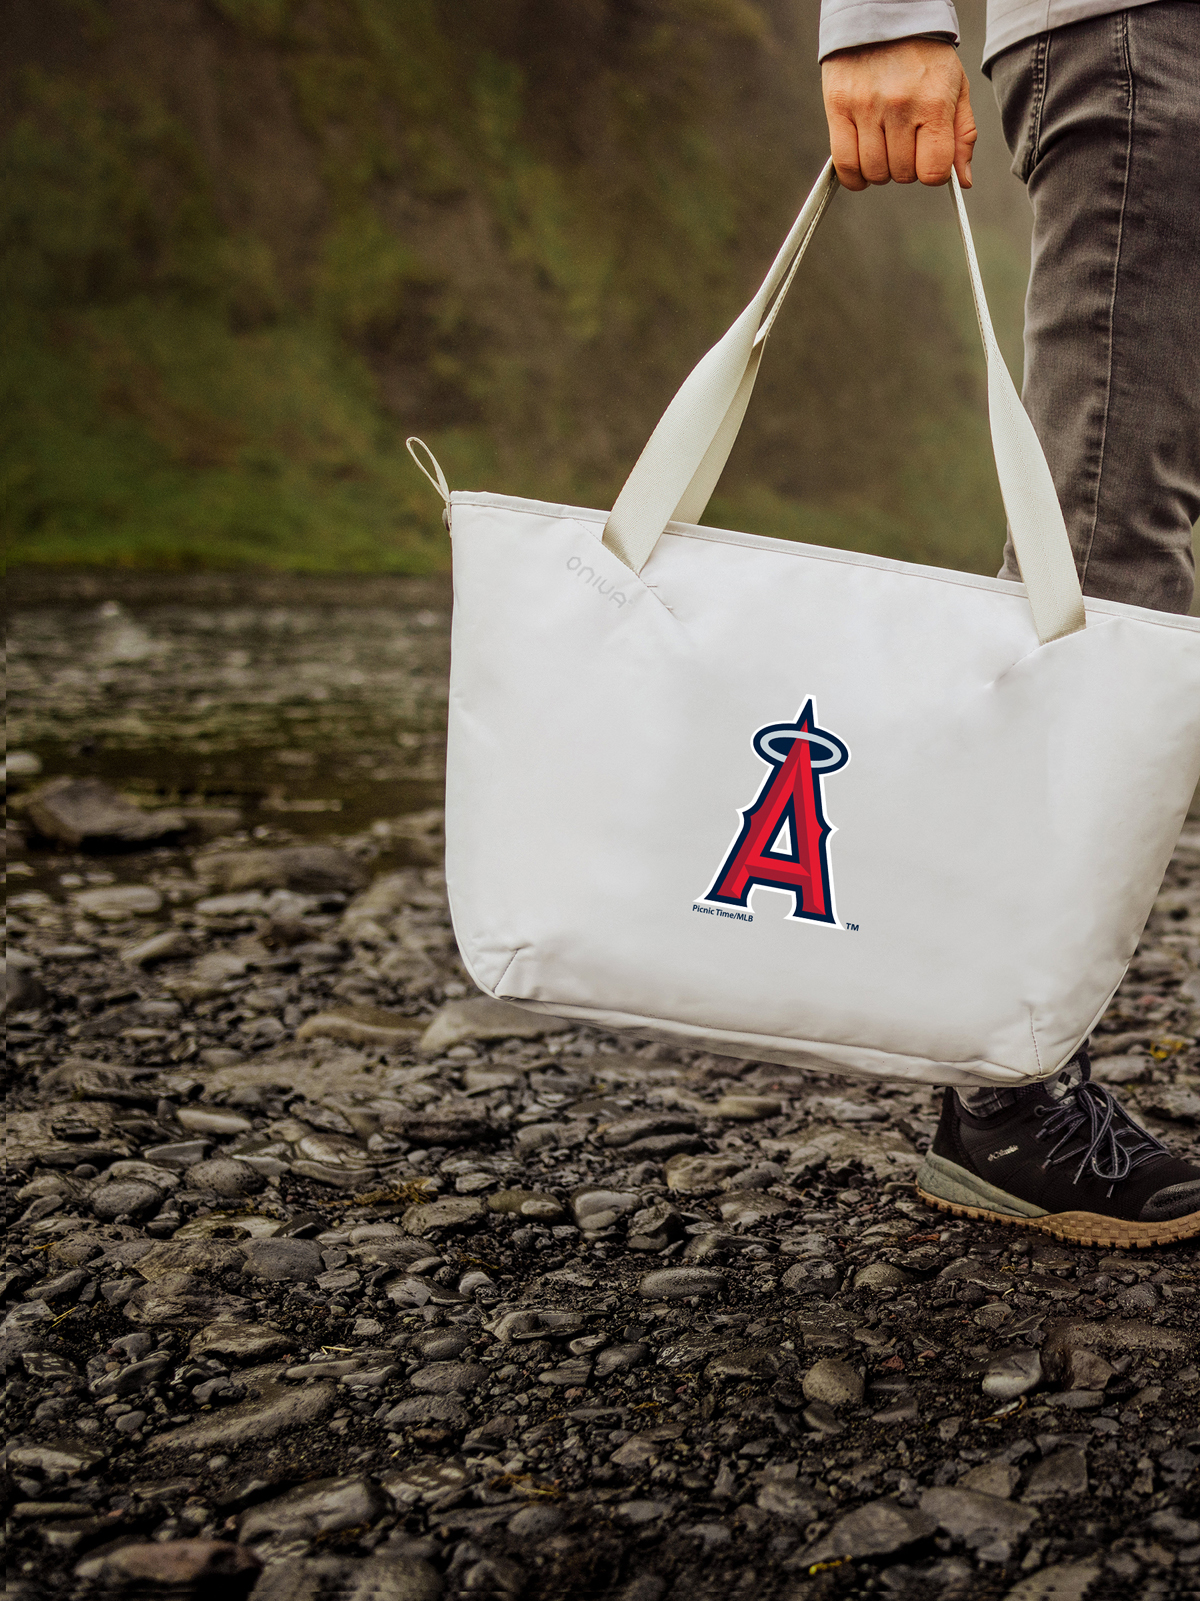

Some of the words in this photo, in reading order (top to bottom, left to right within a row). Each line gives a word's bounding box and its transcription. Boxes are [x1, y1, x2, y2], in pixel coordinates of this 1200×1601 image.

[700, 696, 842, 927] A
[692, 904, 715, 916] Picnic
[715, 908, 754, 922] Time/MLB
[846, 922, 860, 932] TM
